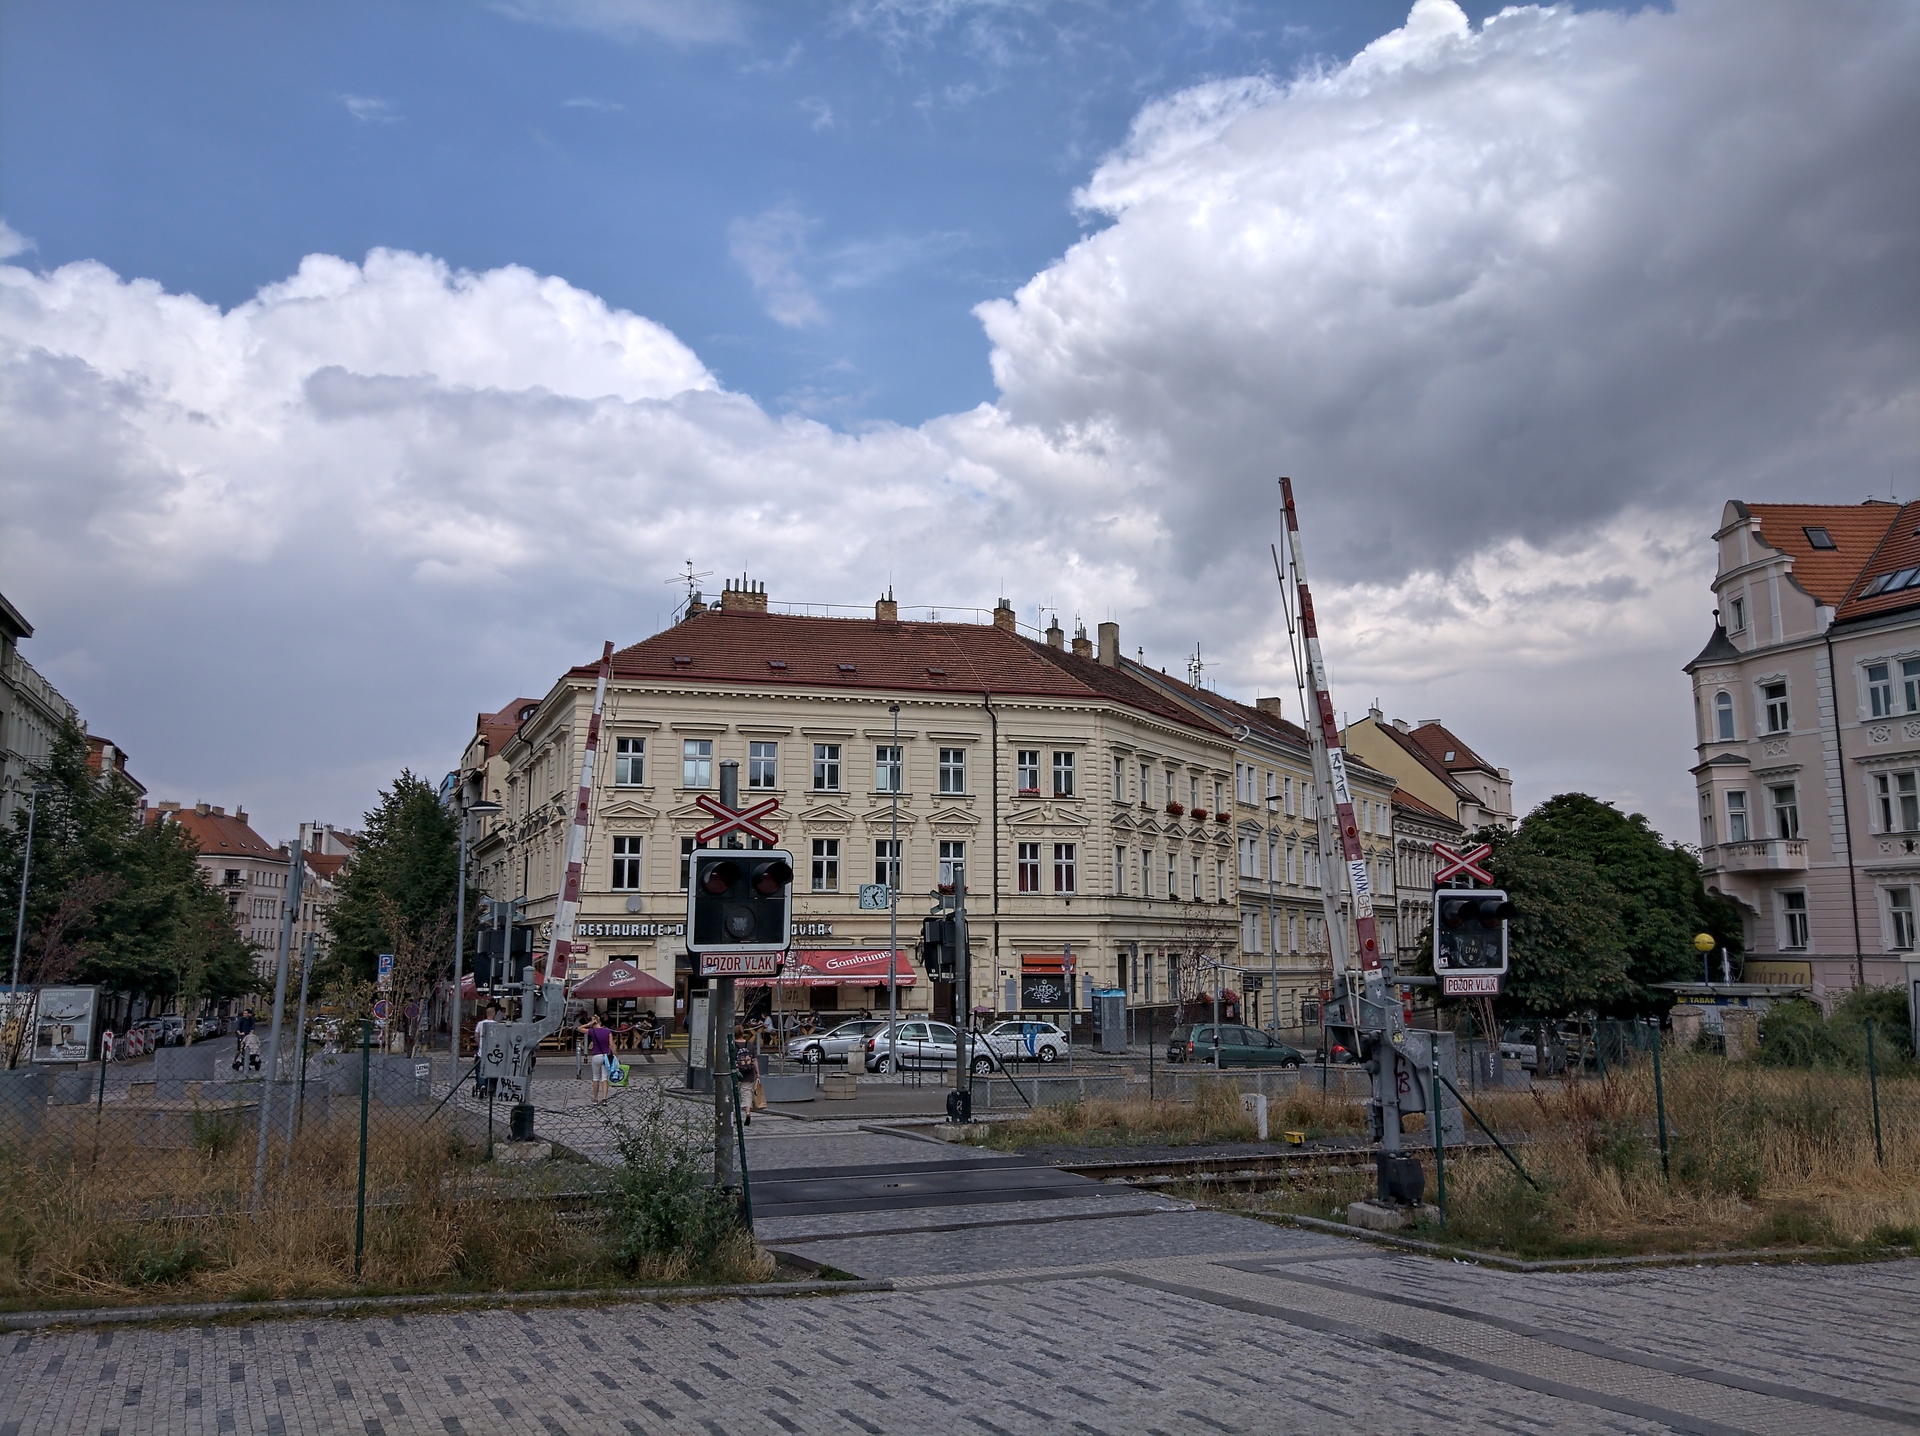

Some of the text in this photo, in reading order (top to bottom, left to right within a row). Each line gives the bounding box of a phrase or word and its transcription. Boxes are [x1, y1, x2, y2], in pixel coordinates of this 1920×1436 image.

[578, 923, 825, 936] RESTAURACE D OVNA
[706, 956, 741, 971] POZOR
[745, 956, 772, 970] VLAK
[826, 950, 892, 969] Gambrinus
[1448, 979, 1496, 991] POZOR VLAK
